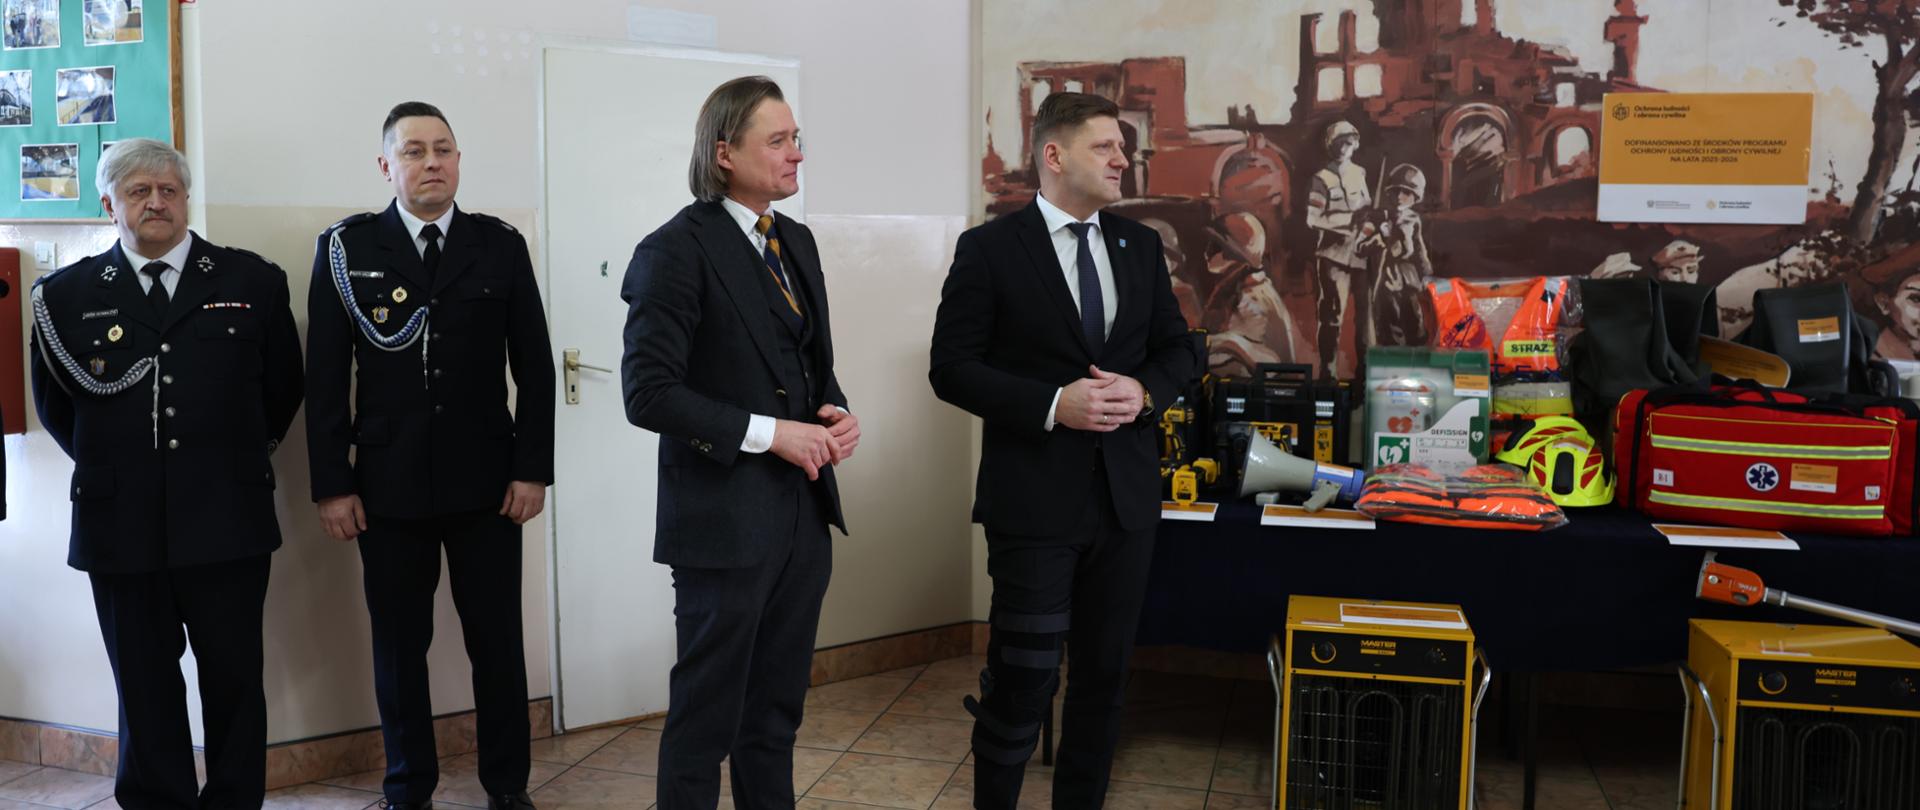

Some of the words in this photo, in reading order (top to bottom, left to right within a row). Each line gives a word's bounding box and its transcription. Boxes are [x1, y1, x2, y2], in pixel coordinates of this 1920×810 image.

[1663, 104, 1690, 112] ludności
[1704, 137, 1741, 146] ŚRODKÓW
[1668, 146, 1705, 154] LUDNOŚCI
[1360, 640, 1397, 649] MASTER
[1815, 668, 1857, 678] MASTER
